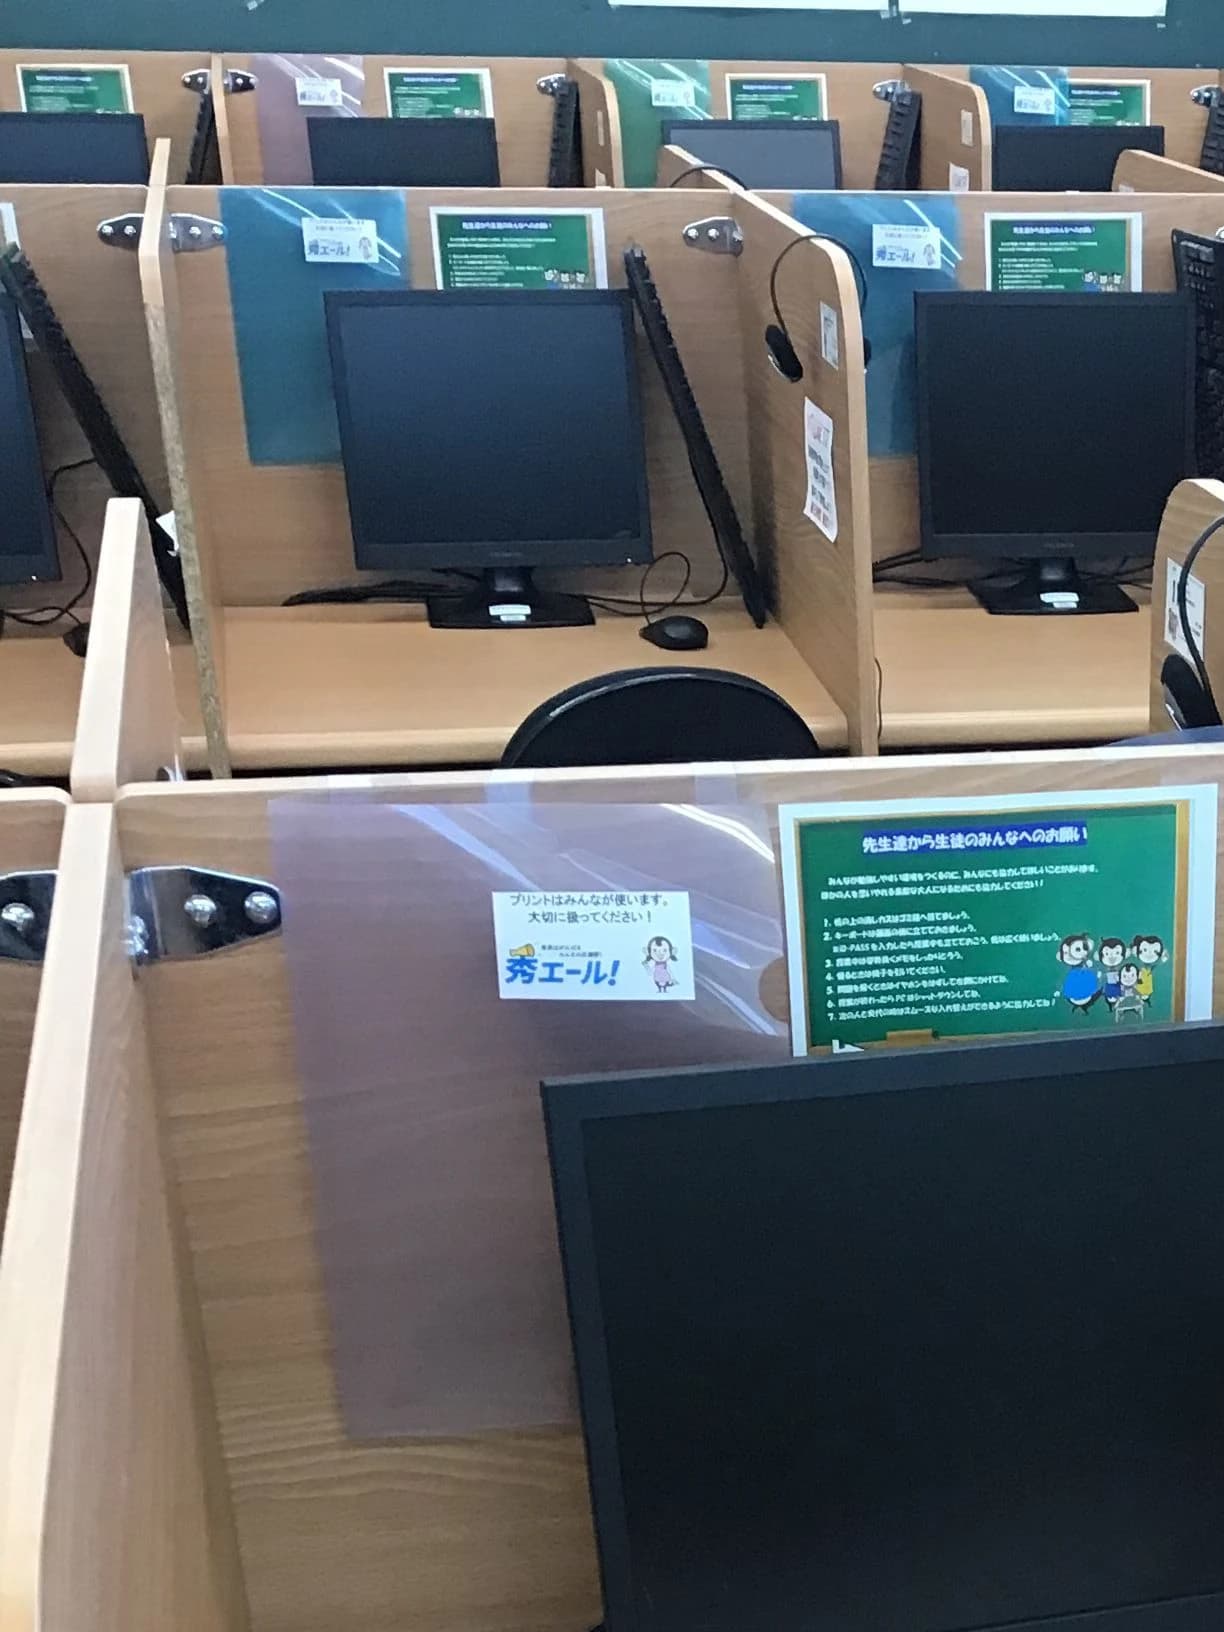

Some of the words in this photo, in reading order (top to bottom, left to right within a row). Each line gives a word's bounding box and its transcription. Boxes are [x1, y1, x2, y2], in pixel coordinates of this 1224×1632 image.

[862, 826, 1088, 853] 先生達から生徒のみんなへのお願い
[510, 893, 668, 907] プリントはみんなが使います。
[528, 910, 652, 923] 大切に扱ってください！
[505, 957, 620, 986] 秀エール!
